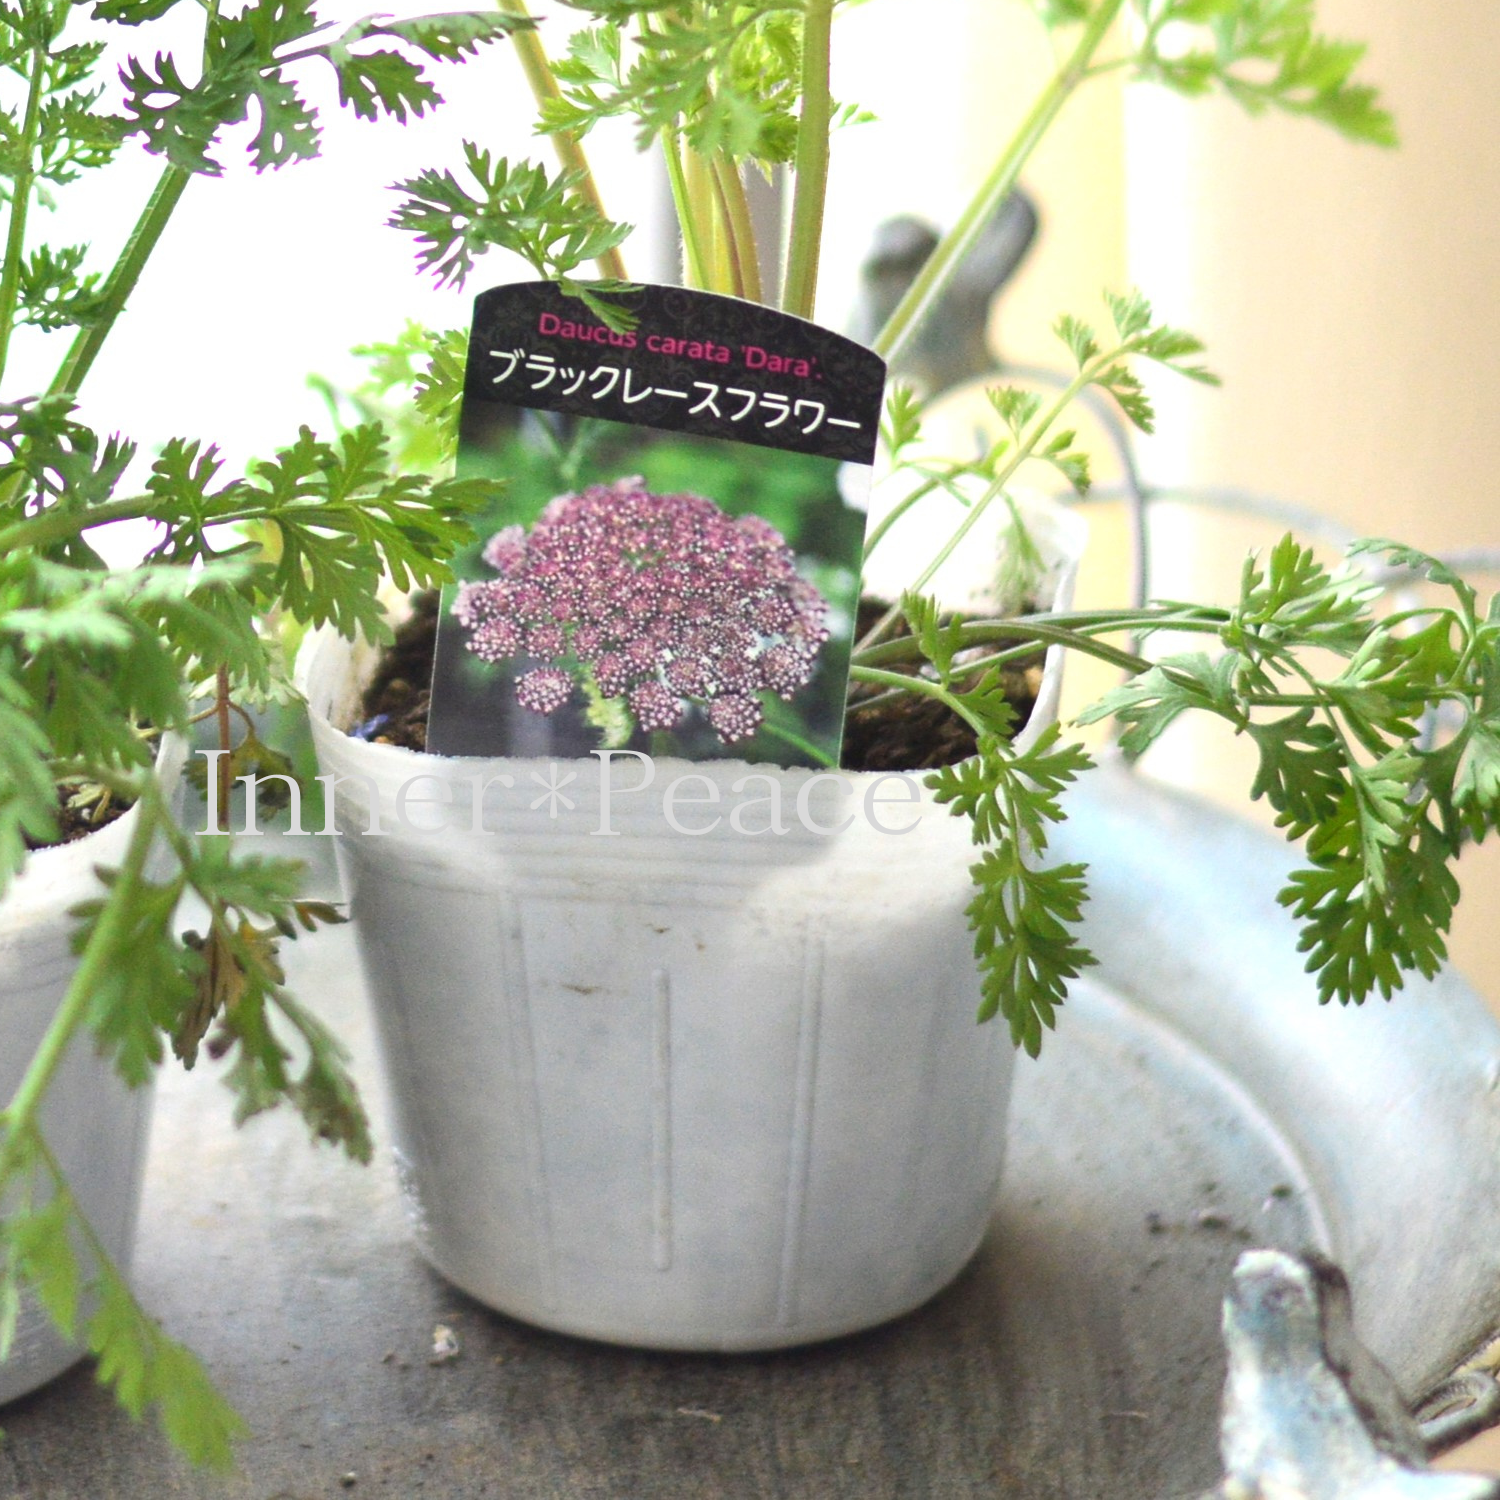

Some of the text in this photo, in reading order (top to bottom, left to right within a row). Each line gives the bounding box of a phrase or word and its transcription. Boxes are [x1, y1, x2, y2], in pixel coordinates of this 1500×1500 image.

[539, 312, 638, 349] Daucus
[645, 334, 731, 365] carata
[489, 348, 861, 435] ブラックレースフラワー
